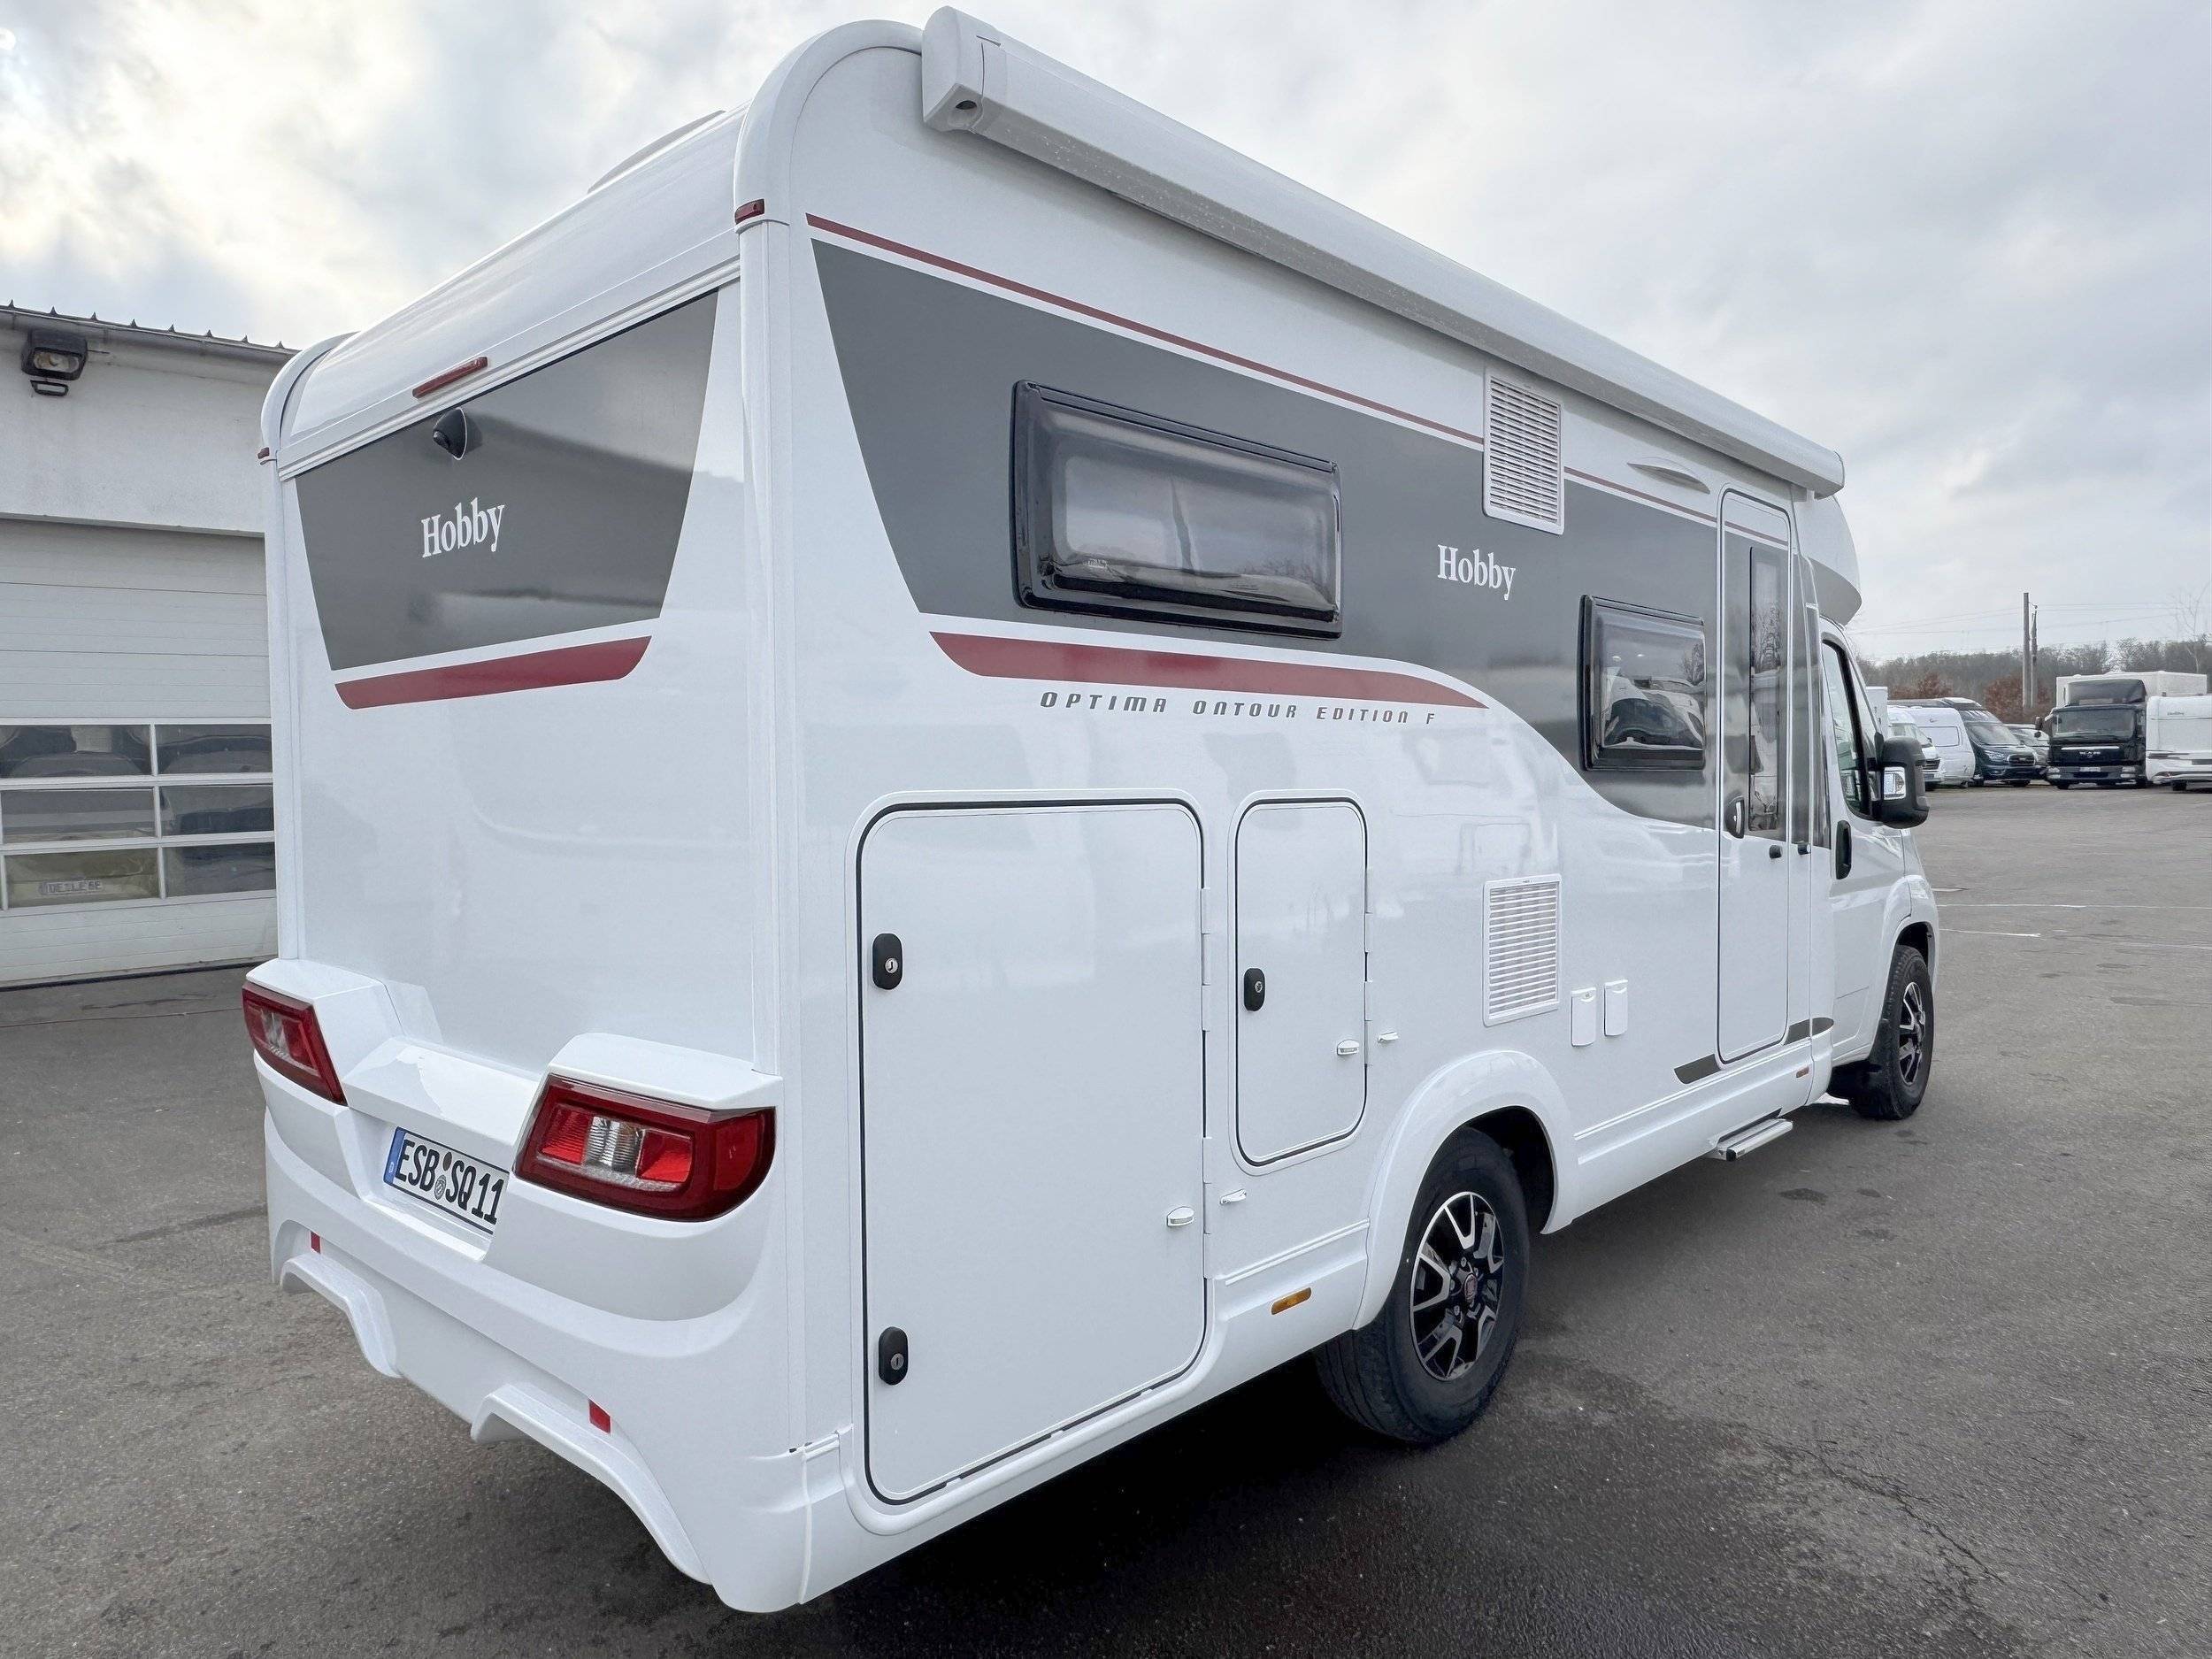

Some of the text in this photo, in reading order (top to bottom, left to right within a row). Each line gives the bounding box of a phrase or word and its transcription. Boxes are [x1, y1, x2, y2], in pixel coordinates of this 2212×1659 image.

[420, 496, 505, 558] Hobby
[1437, 544, 1517, 601] Hobby
[1040, 691, 1435, 725] OPTIMA ONTOUR EDITION F
[395, 1139, 441, 1192] ESB
[445, 1160, 477, 1211] SQ
